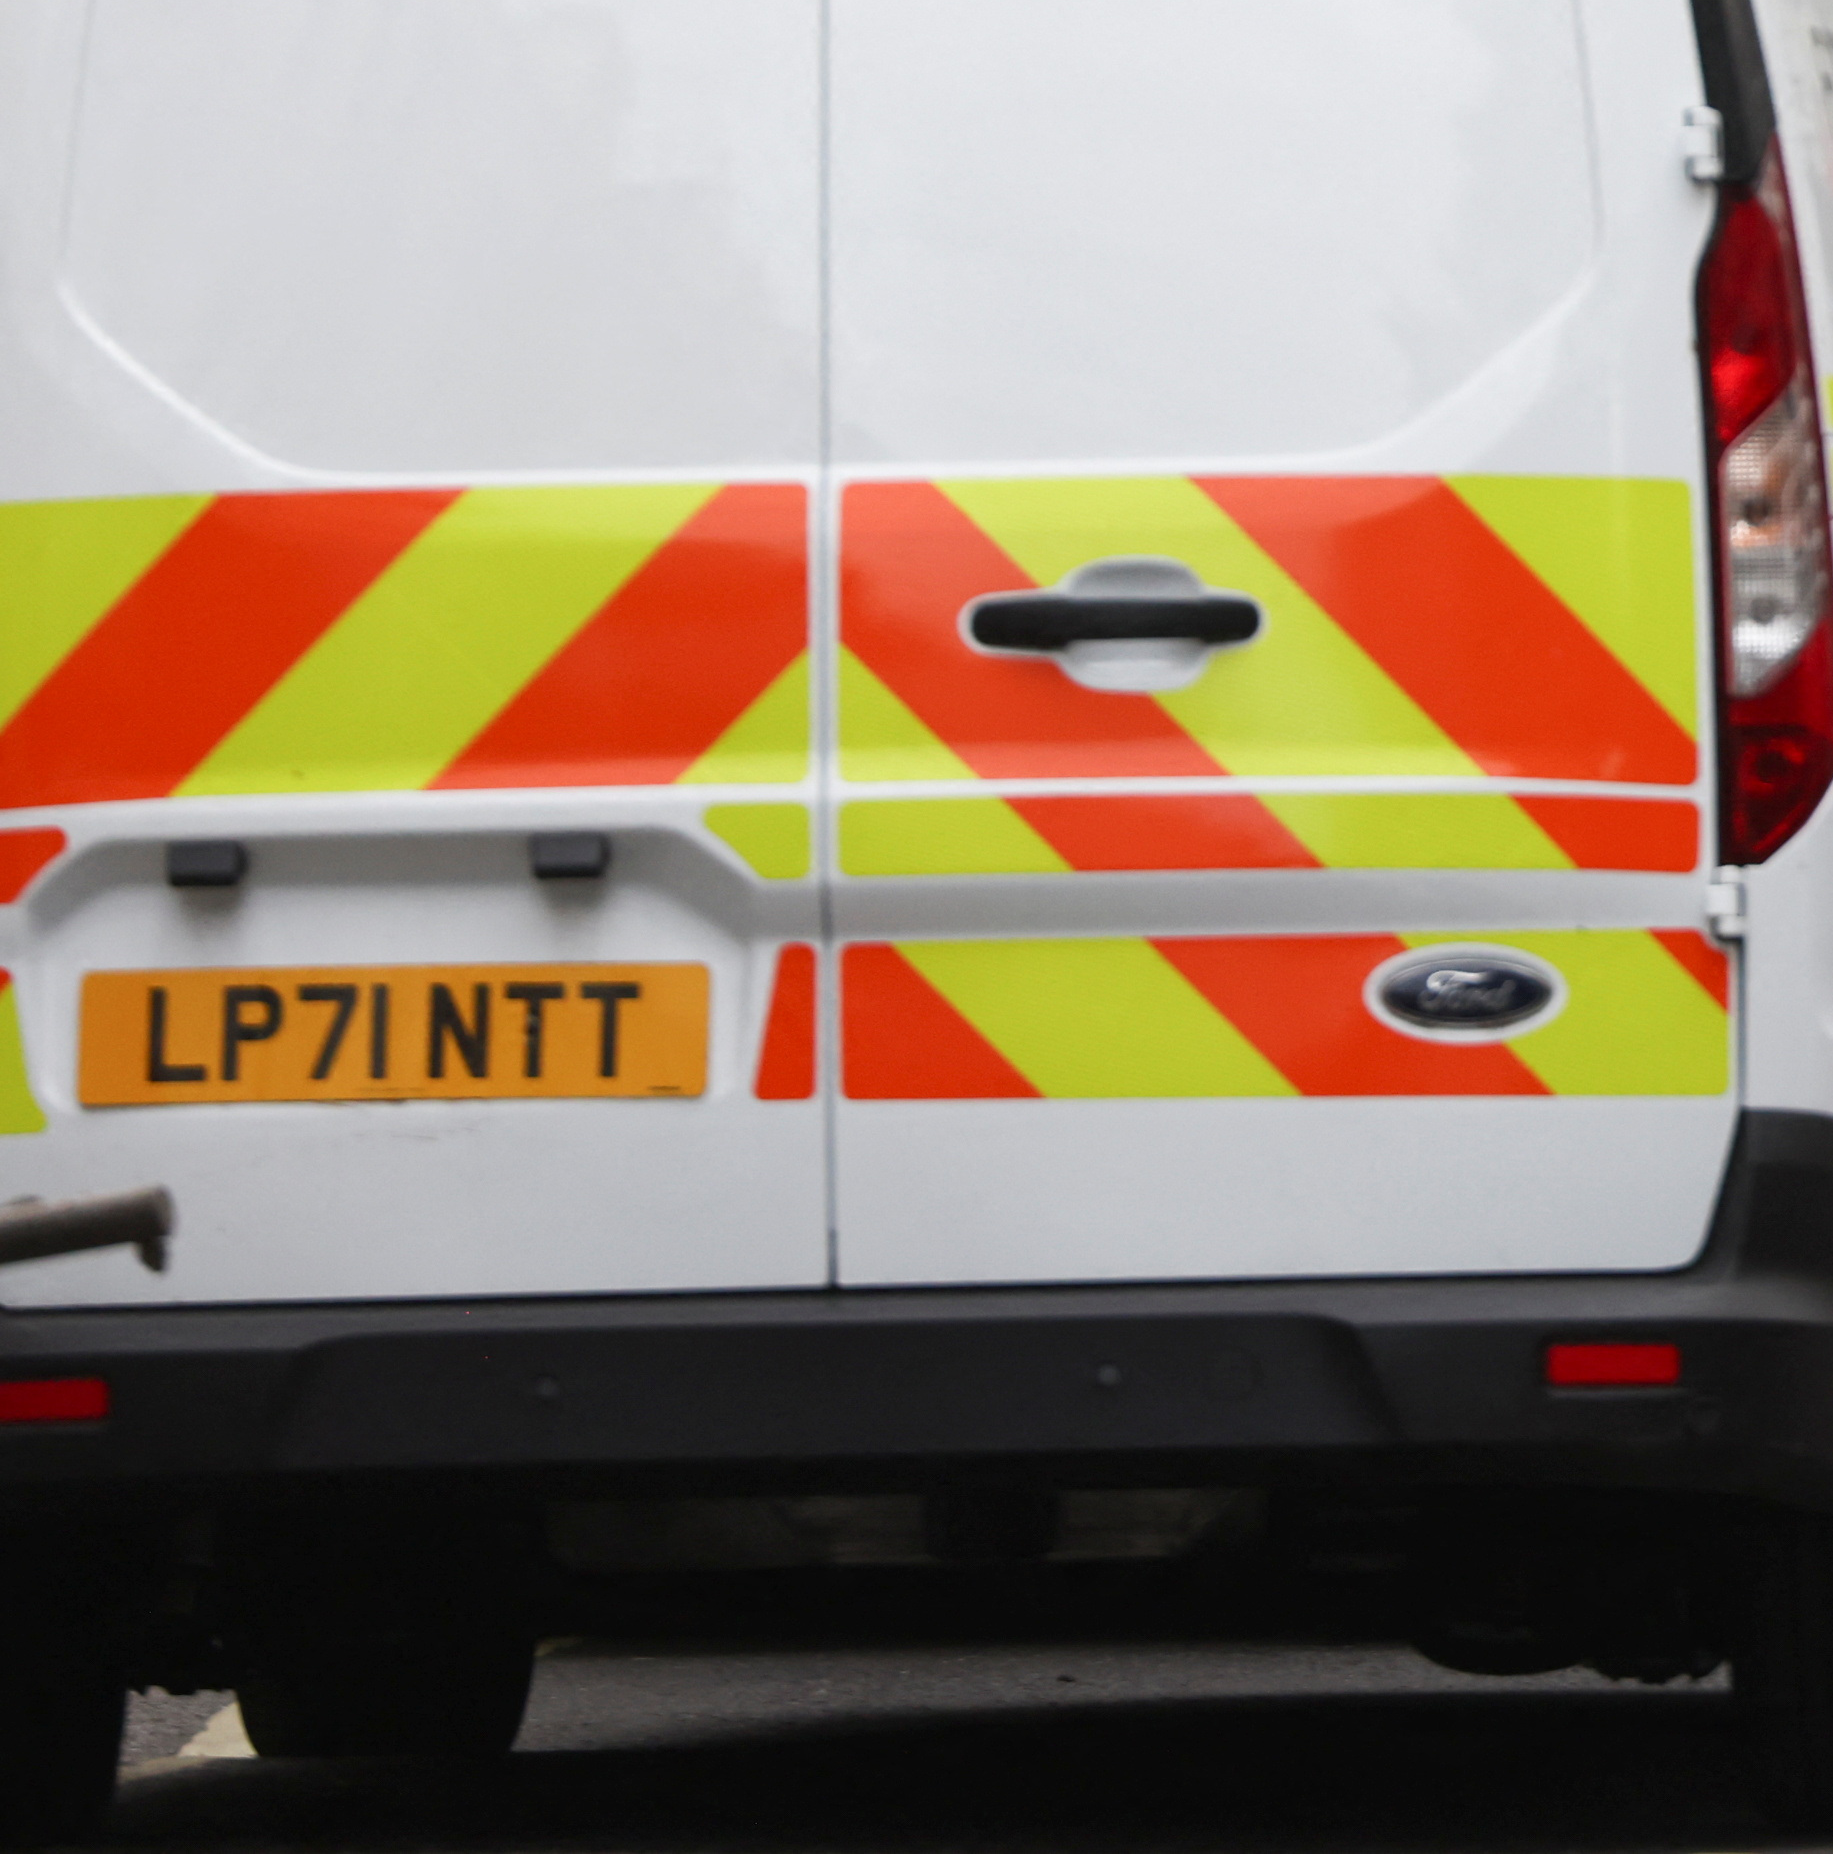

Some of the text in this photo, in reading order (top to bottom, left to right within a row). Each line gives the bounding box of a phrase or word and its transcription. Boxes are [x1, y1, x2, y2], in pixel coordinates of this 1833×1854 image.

[1418, 969, 1516, 1014] Ford
[145, 980, 642, 1082] LP71 NTT
